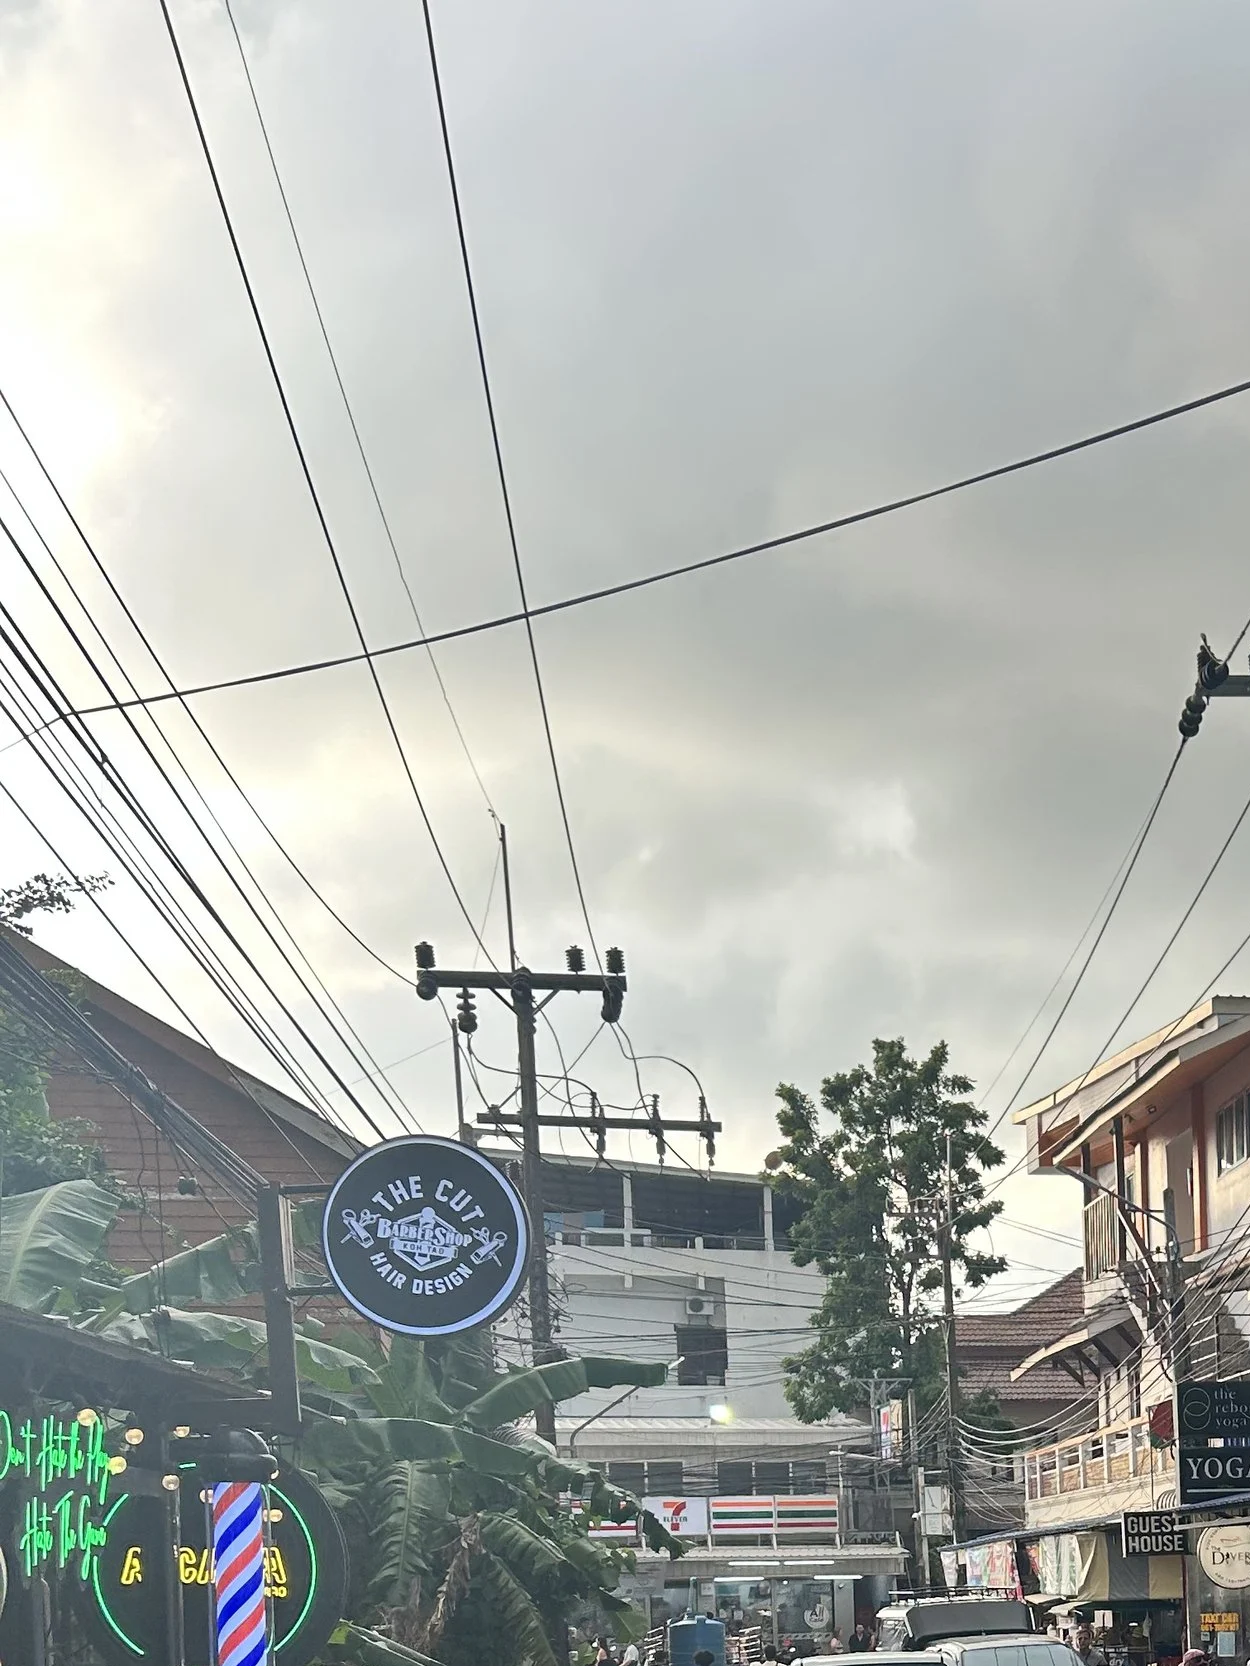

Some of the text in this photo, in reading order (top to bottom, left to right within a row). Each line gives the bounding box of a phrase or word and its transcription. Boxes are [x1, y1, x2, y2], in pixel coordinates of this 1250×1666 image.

[371, 1176, 485, 1222] THE CUT
[403, 1242, 445, 1254] KOH TAO
[370, 1252, 473, 1295] HAIR DESIGN
[1214, 1387, 1237, 1400] the
[1215, 1417, 1248, 1428] yoga
[1128, 1535, 1184, 1553] HOUSE
